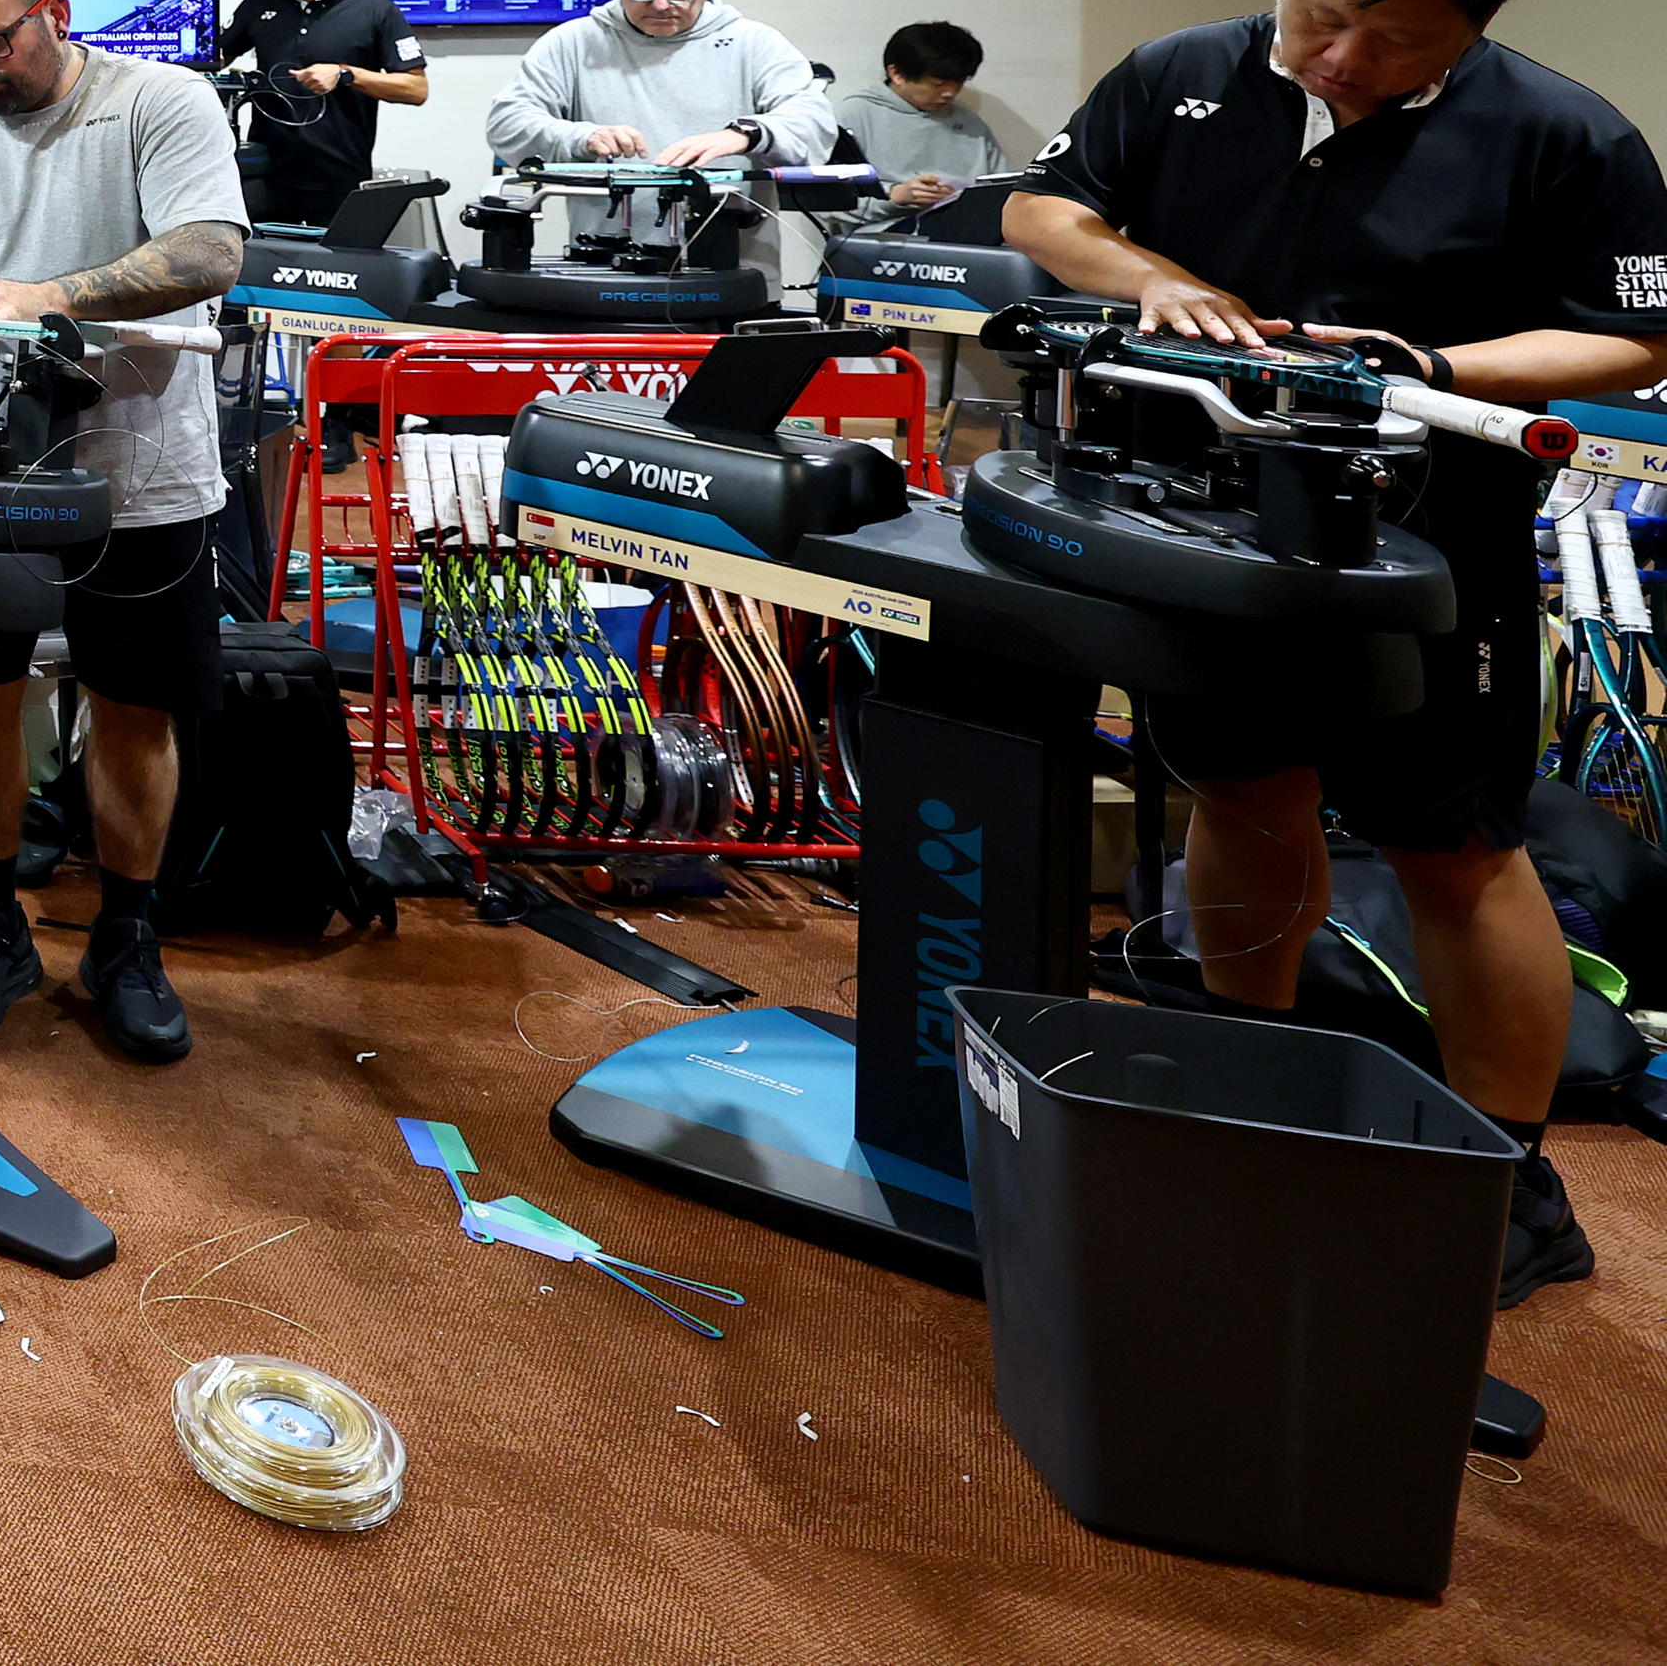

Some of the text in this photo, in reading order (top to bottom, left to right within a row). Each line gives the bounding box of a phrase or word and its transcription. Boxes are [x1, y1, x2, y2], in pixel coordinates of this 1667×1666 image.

[81, 32, 179, 41] AUSTRALIAN OPEN 2025
[99, 113, 121, 124] YONEX
[908, 262, 967, 284] YONEX
[1614, 255, 1667, 273] YONE
[304, 269, 359, 291] YONEX
[599, 291, 697, 302] PRECISION
[282, 316, 345, 334] GIANLUCA
[882, 308, 937, 324] PIN LAY
[1591, 461, 1609, 469] KOR
[628, 459, 714, 501] YONEX
[572, 527, 643, 560] MELVIN
[649, 546, 690, 571] TAN
[843, 597, 873, 614] AO
[895, 612, 919, 624] YONEX
[1478, 661, 1491, 694] YONEX
